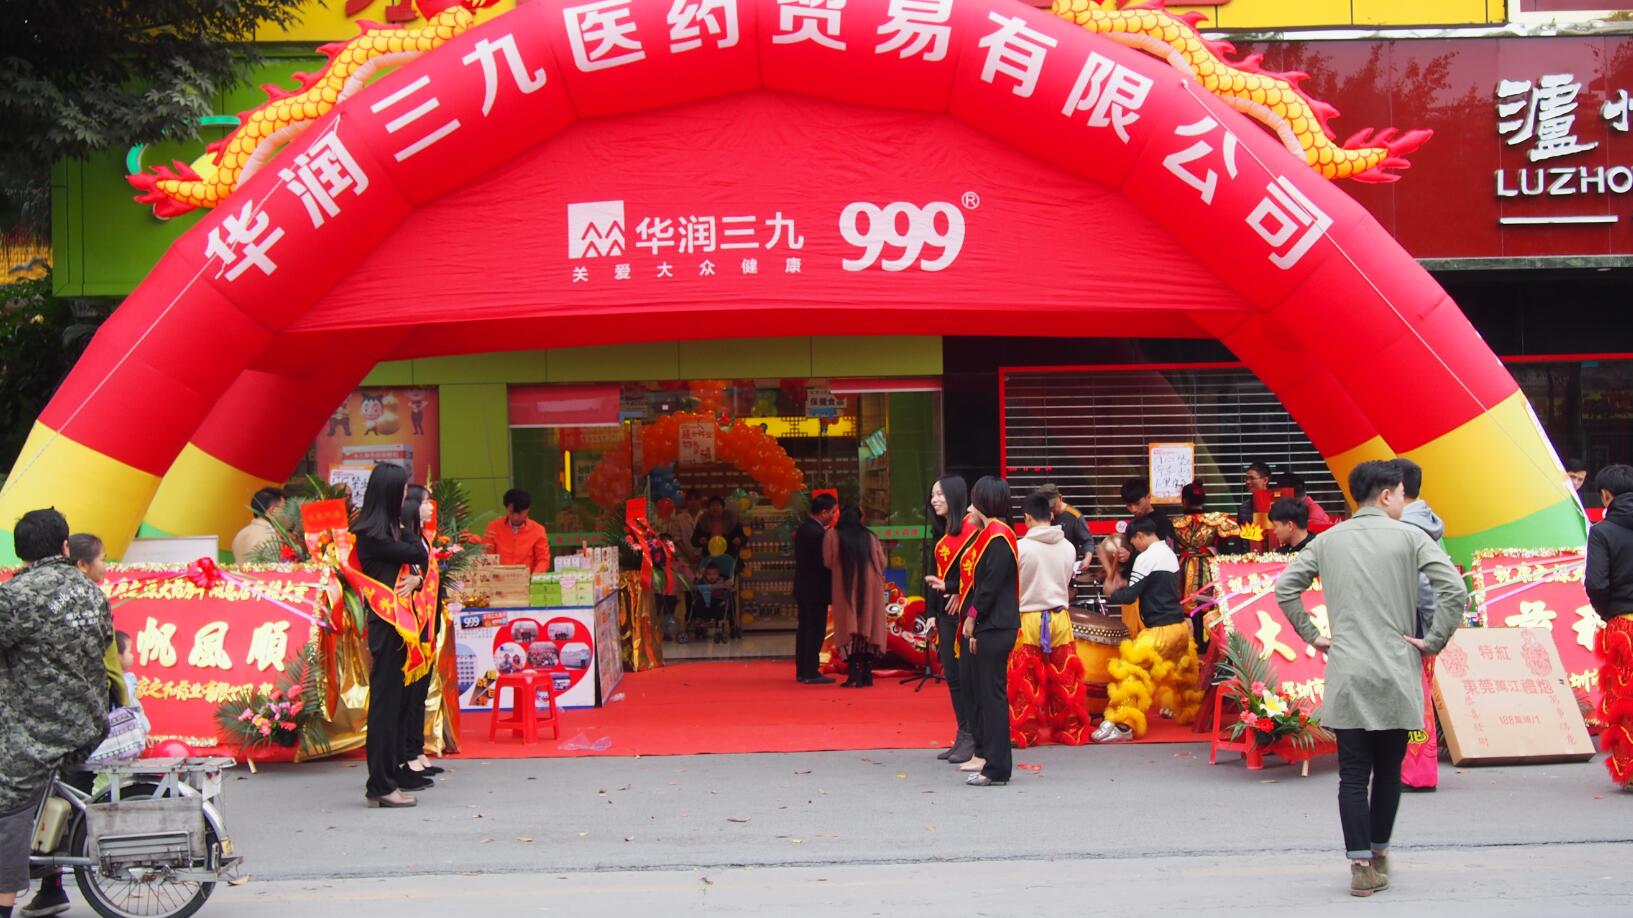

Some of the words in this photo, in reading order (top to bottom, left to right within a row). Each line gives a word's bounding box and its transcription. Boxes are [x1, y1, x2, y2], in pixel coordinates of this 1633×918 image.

[635, 211, 804, 255] 华润三九
[572, 256, 802, 283] 关爱大众健康
